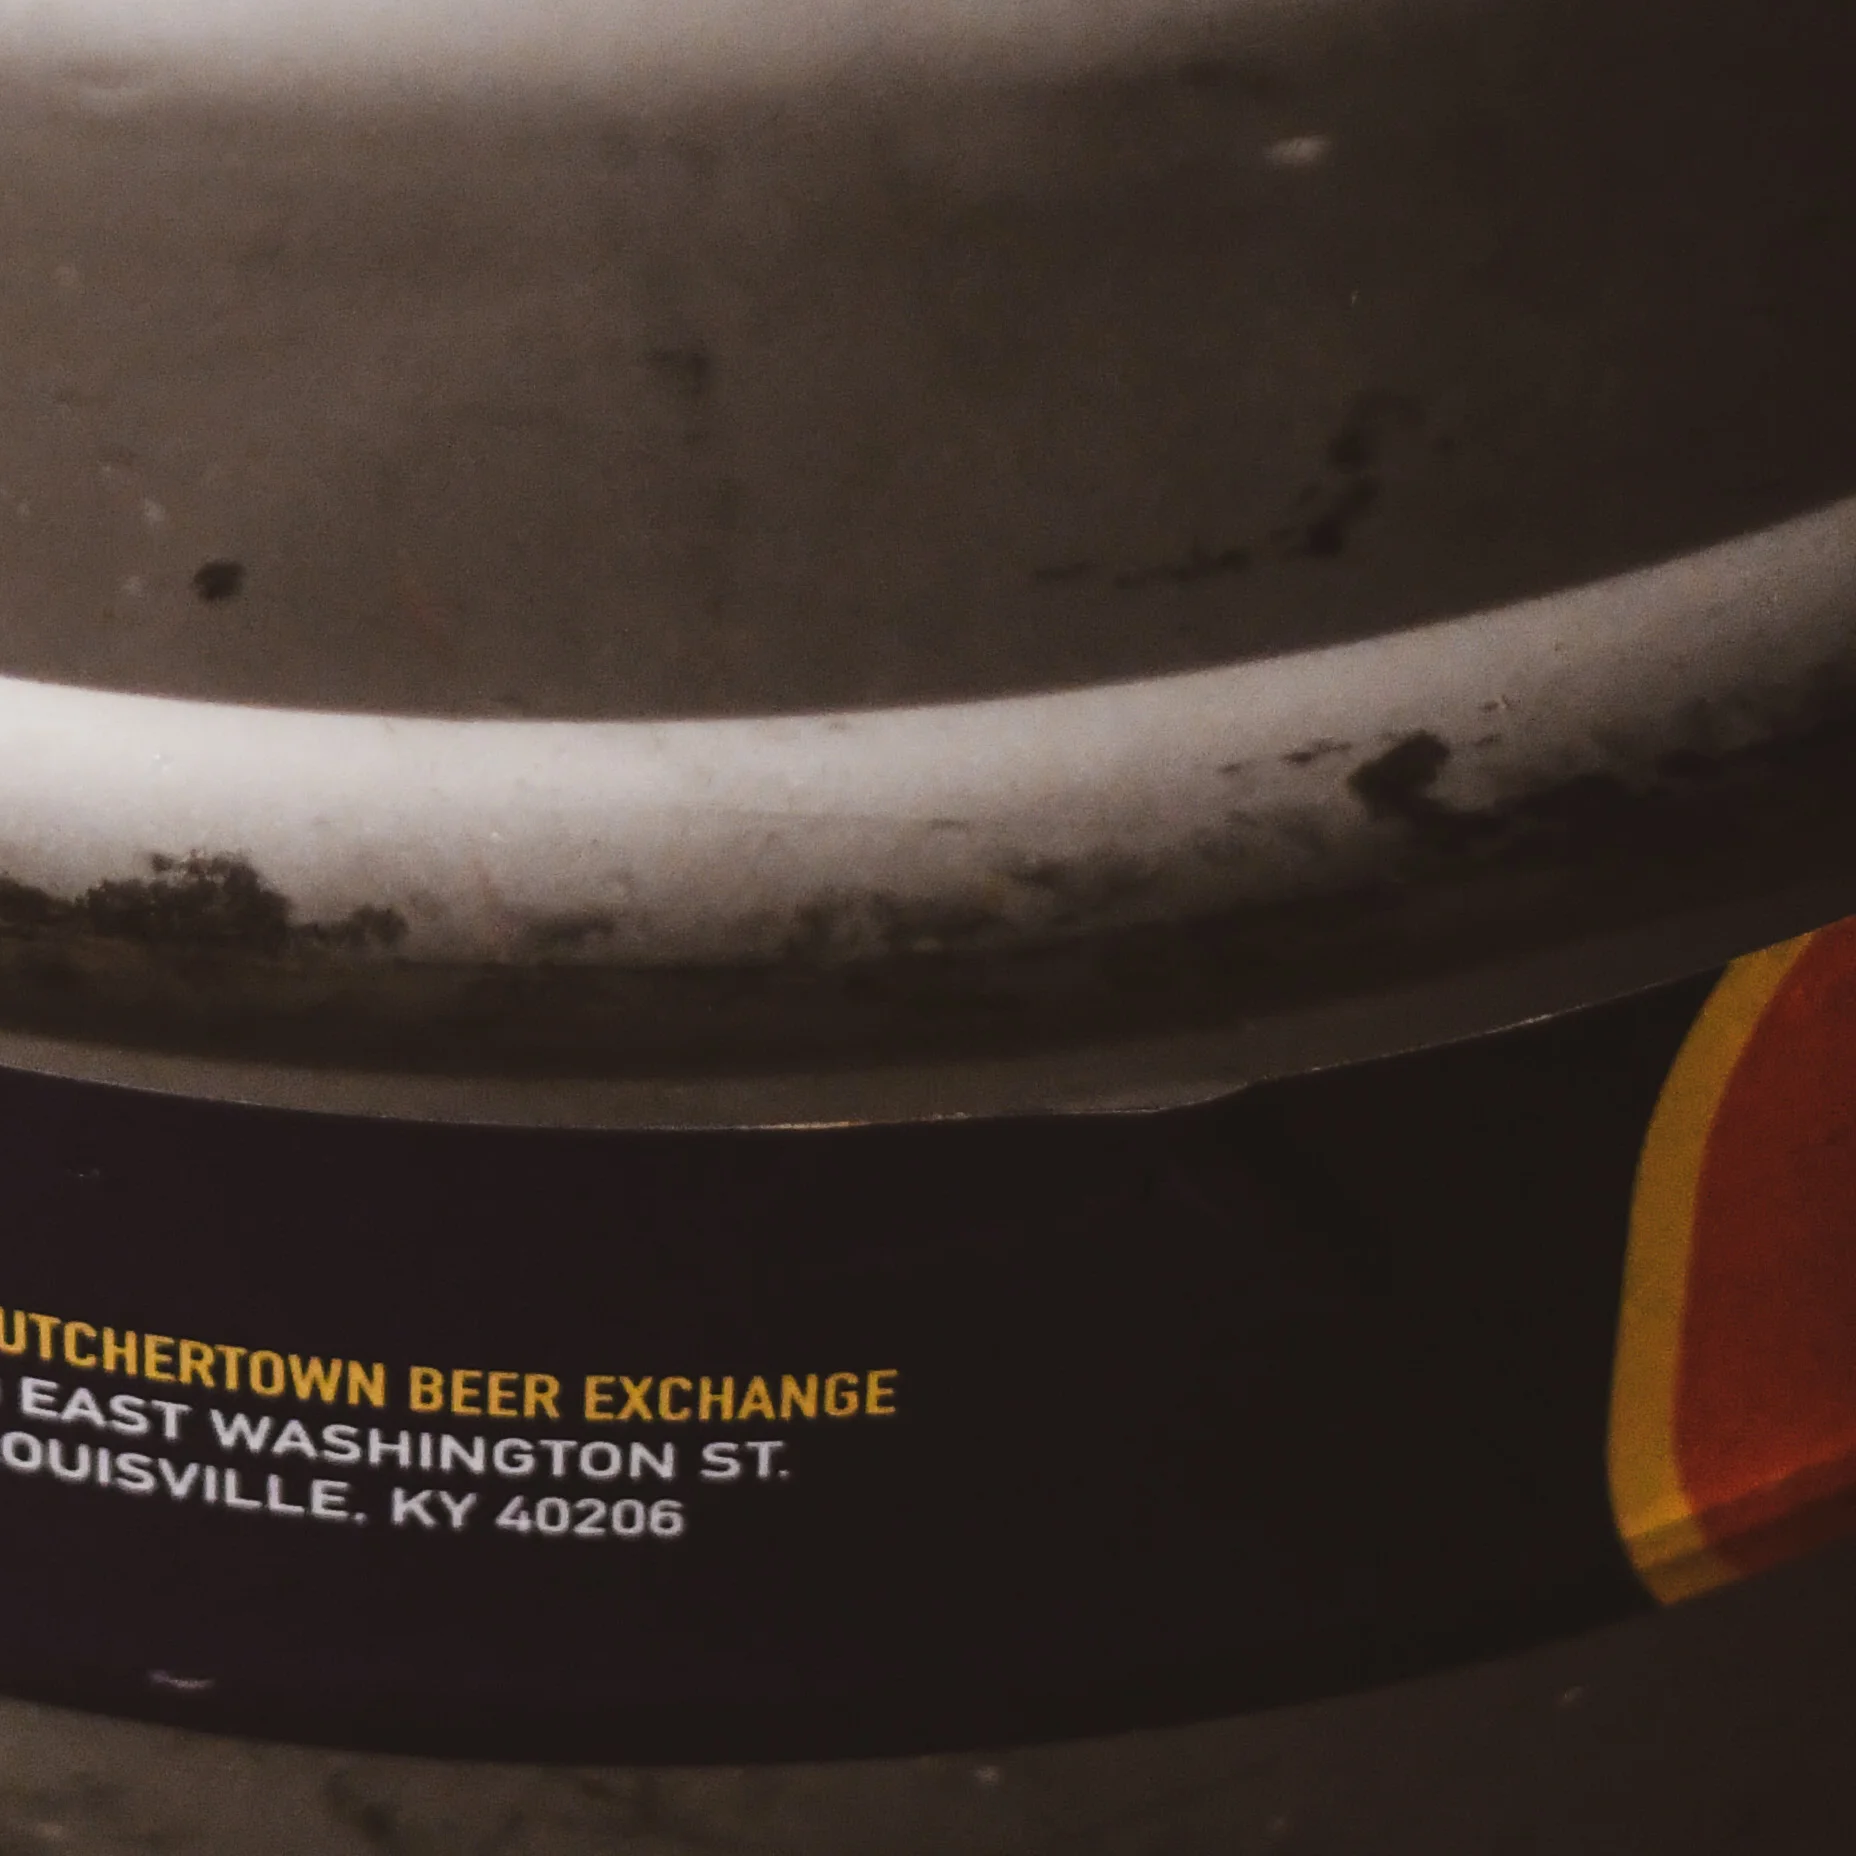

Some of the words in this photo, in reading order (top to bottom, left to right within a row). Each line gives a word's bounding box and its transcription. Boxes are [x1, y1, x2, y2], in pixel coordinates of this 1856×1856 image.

[408, 1365, 561, 1420] BEER
[583, 1368, 900, 1422] EXCHANGE
[18, 1375, 192, 1441] EAST
[210, 1408, 677, 1480] WASHINGTON
[698, 1440, 791, 1479] ST.
[390, 1488, 479, 1529] KY
[495, 1495, 686, 1538] 40206
